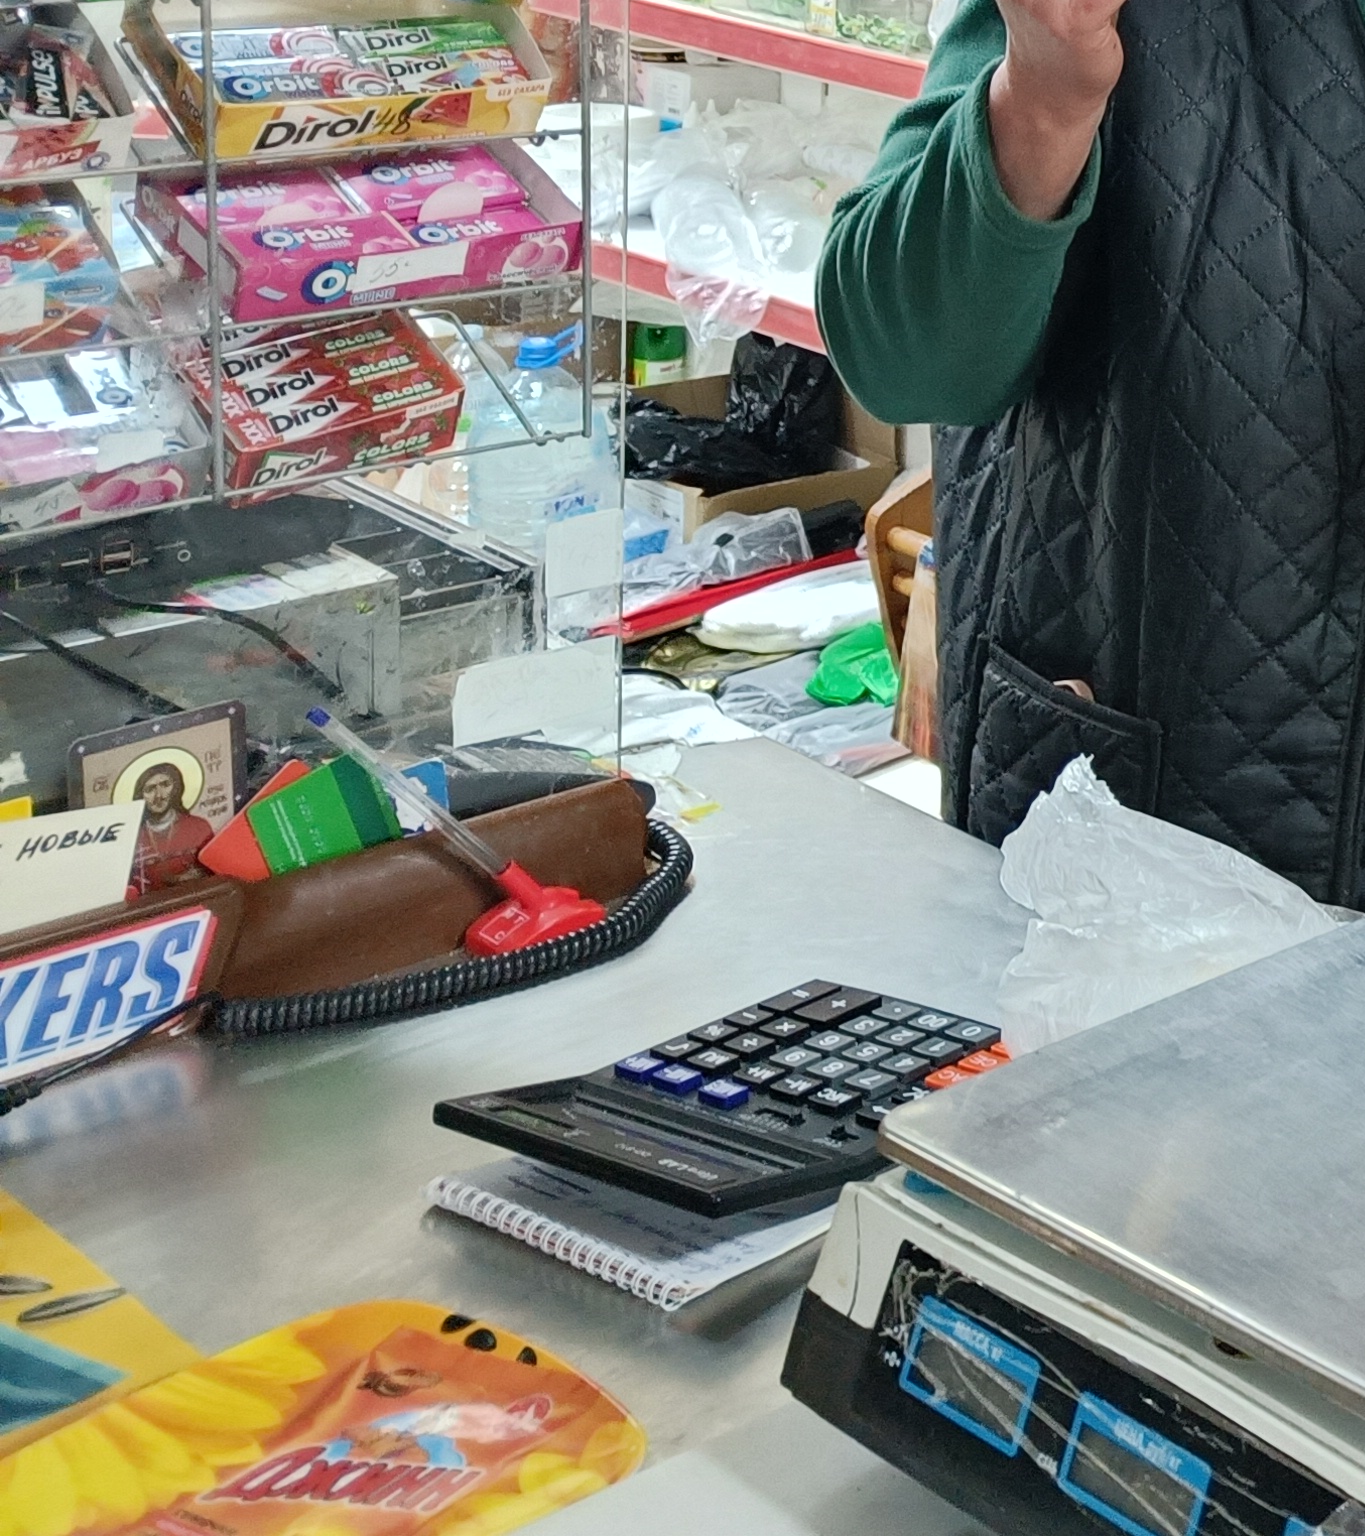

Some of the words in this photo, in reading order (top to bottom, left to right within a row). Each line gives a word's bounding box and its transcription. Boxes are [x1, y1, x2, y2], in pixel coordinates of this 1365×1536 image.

[367, 28, 430, 51] Dirol
[385, 56, 448, 78] Dirol
[225, 75, 319, 98] Orbit
[254, 110, 375, 150] Dirol
[367, 159, 456, 185] Orbit
[253, 223, 354, 251] Orbit
[410, 219, 503, 245] Orbit
[325, 329, 386, 352] COLORS
[222, 344, 292, 382] Dirol
[349, 353, 410, 378] COLORS
[247, 370, 315, 407] Dirol
[372, 380, 434, 404] COLORS
[269, 397, 339, 435] Dirol
[353, 432, 431, 463] COLORS
[253, 449, 328, 487] Dirol
[15, 821, 127, 863] НОВЫЕ
